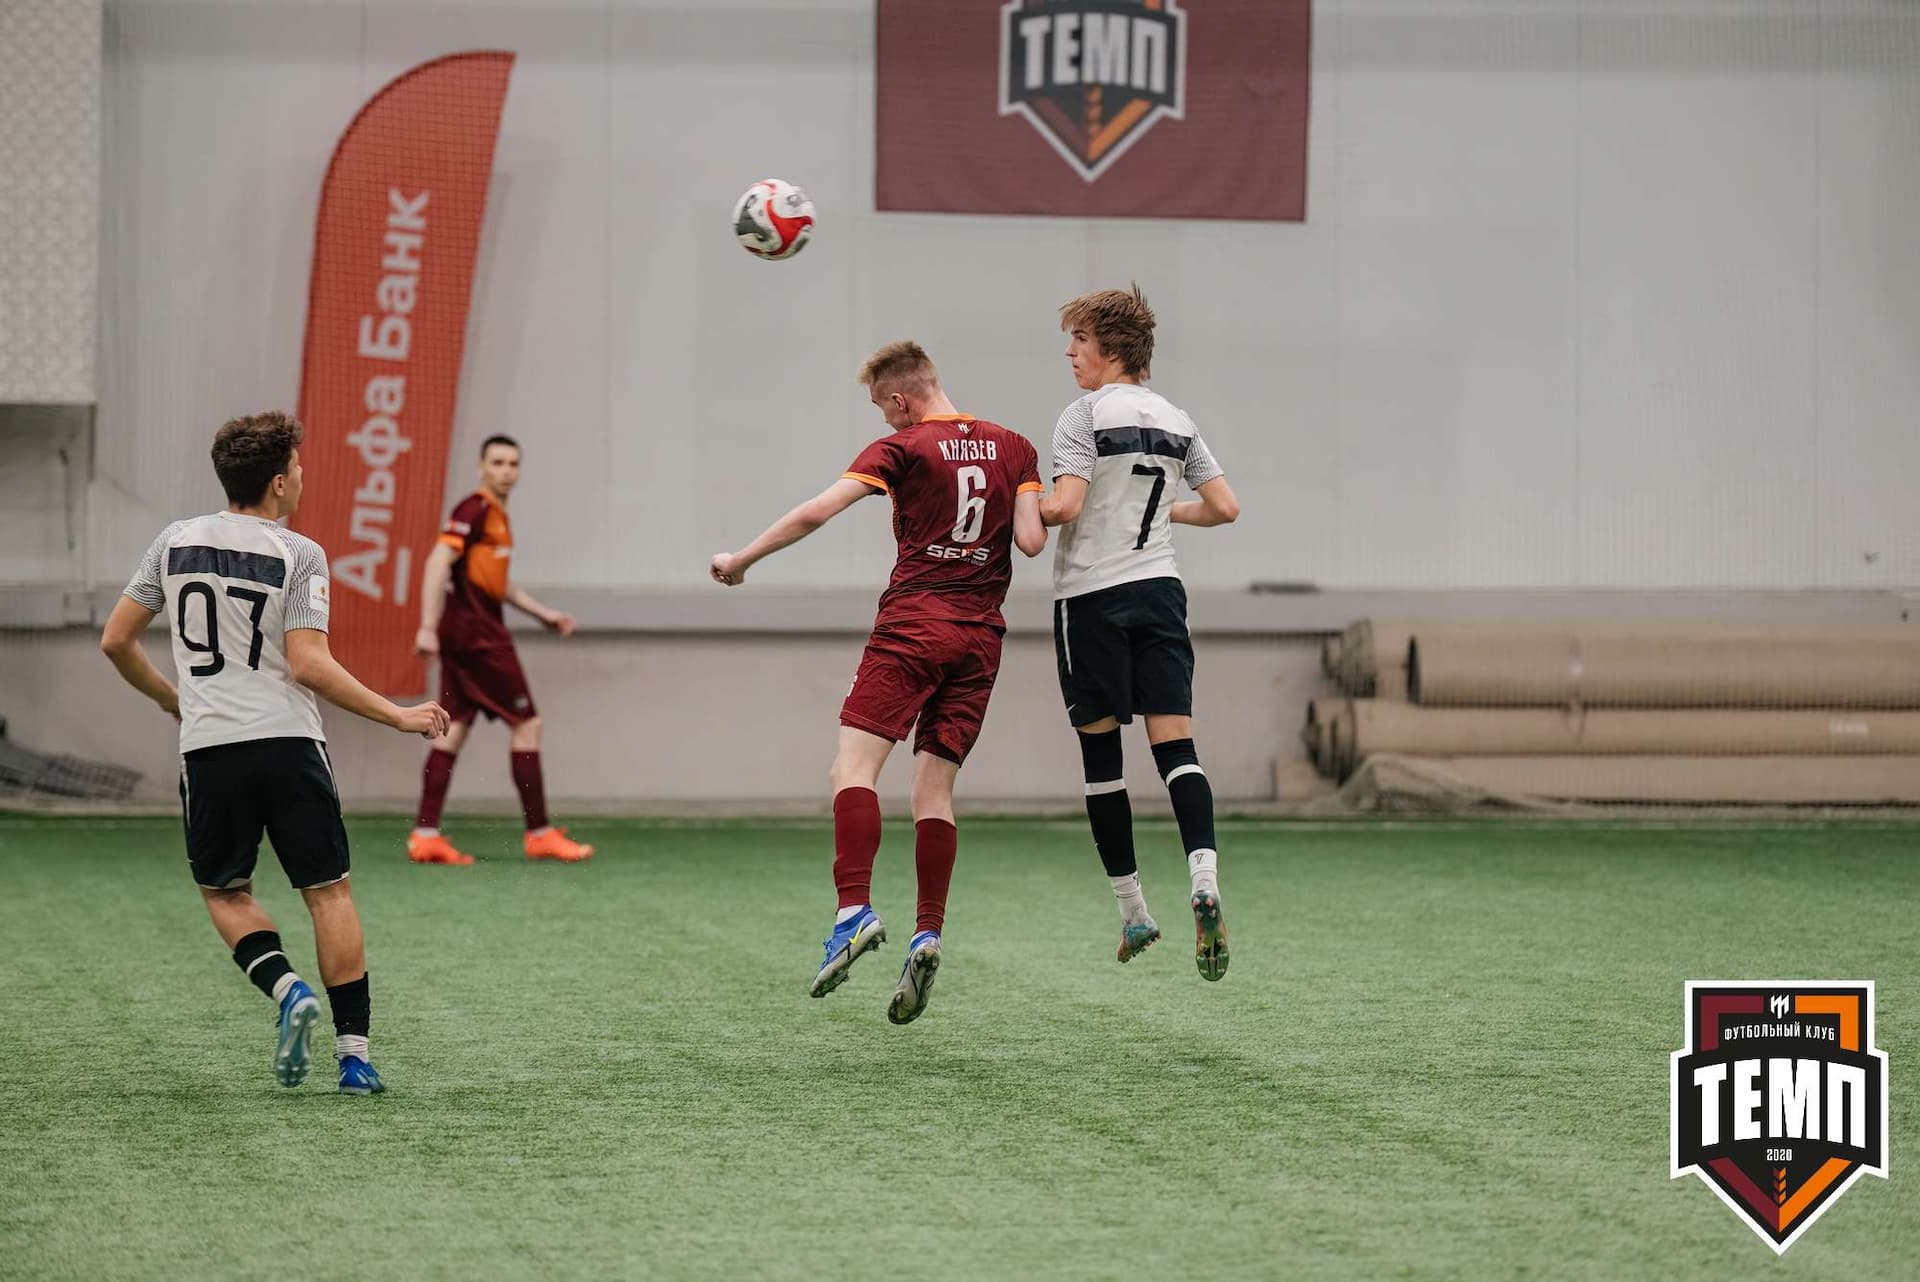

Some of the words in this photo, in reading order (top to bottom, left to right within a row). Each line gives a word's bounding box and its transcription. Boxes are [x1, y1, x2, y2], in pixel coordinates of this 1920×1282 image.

[1019, 12, 1168, 94] ТЕМП
[358, 187, 429, 362] Банк
[331, 375, 412, 600] Альфа
[938, 439, 997, 461] КНЯЗЕВ
[951, 465, 987, 544] 6
[1131, 463, 1166, 551] 7
[178, 581, 268, 677] 97
